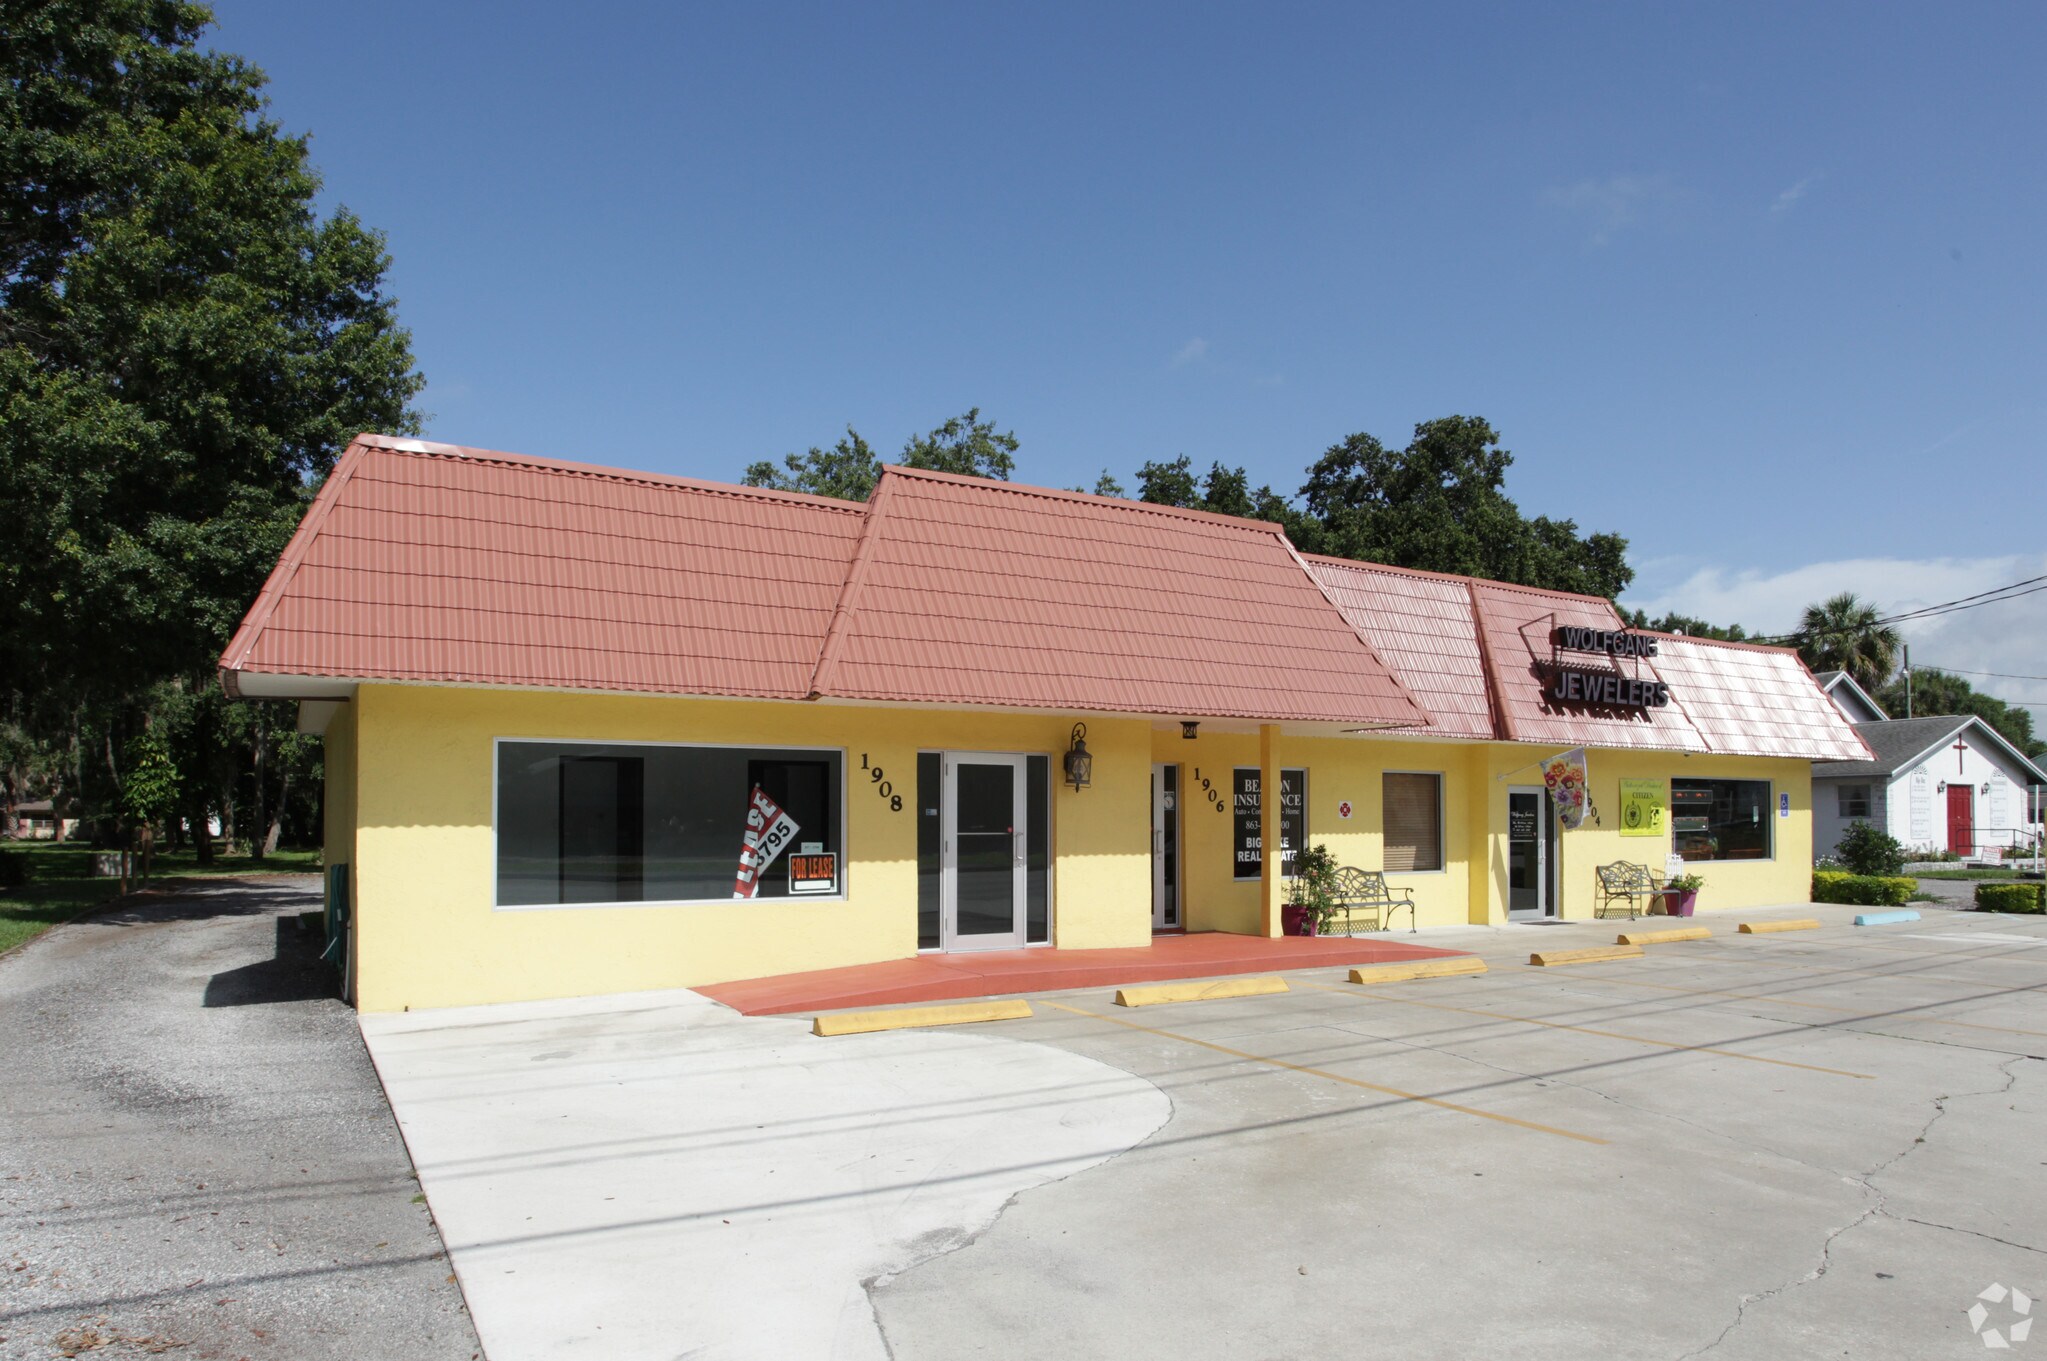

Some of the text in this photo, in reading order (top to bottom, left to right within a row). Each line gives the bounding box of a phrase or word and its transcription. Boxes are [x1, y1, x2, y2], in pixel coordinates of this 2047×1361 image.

[1565, 626, 1658, 657] WOLFGANG
[1555, 671, 1669, 708] JEWELERS
[861, 753, 902, 812] 1908
[1194, 767, 1224, 812] 1906
[1632, 791, 1654, 800] CITIZEN
[1234, 794, 1302, 806] INSUNCE
[1586, 788, 1600, 827] 904
[1246, 837, 1262, 848] BIG
[792, 857, 833, 879] FOR LEASE
[1237, 851, 1262, 862] REAL
